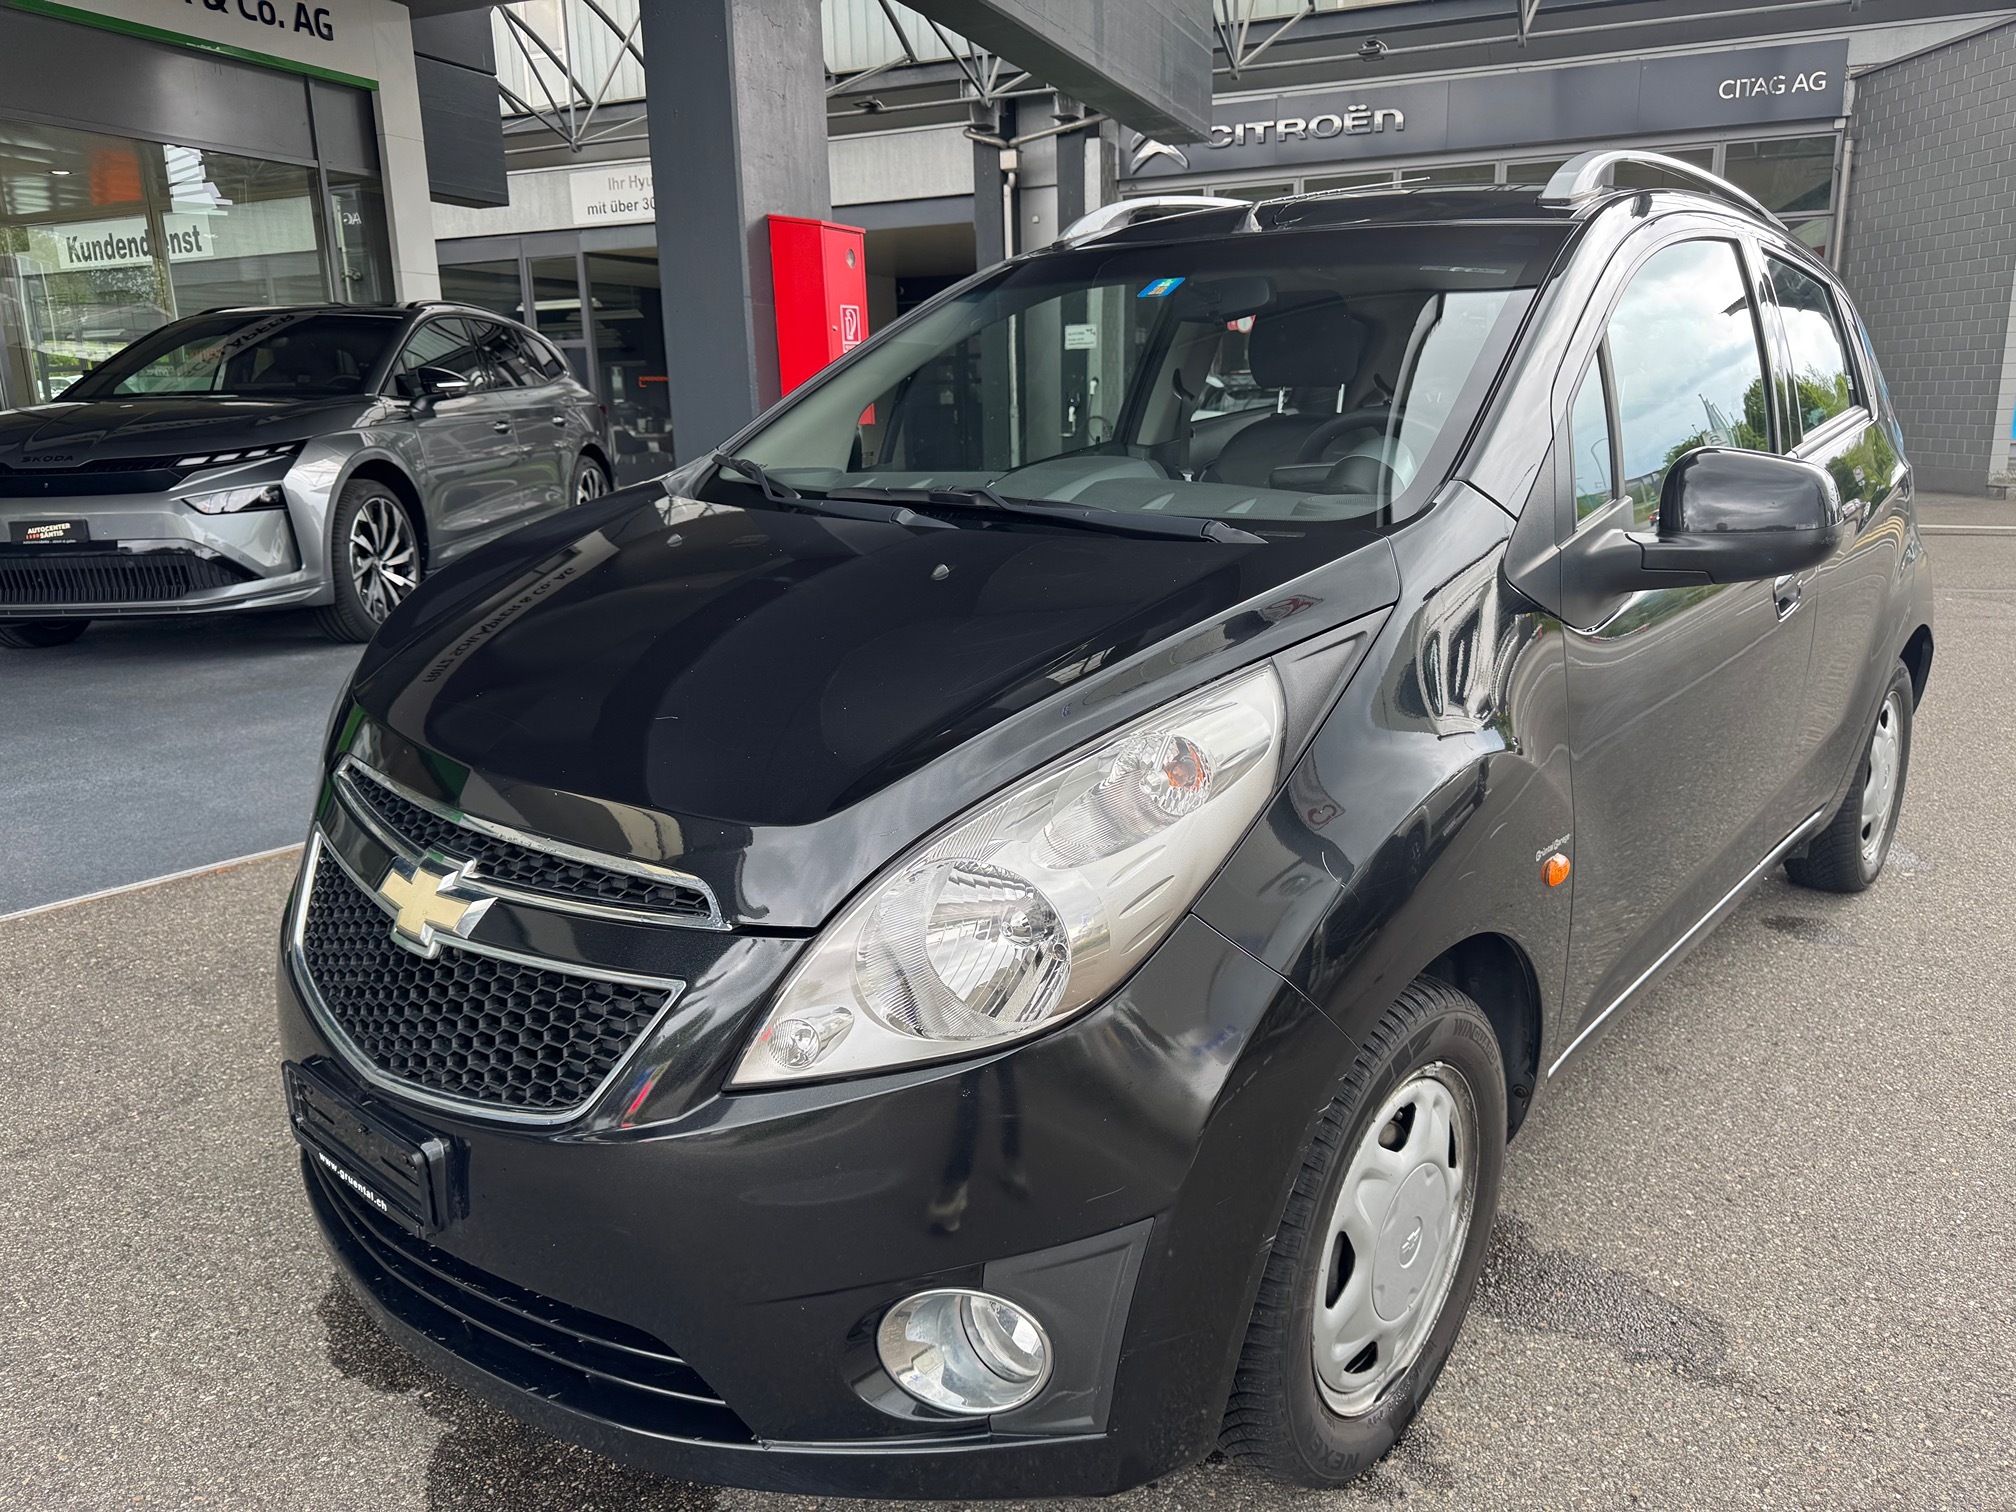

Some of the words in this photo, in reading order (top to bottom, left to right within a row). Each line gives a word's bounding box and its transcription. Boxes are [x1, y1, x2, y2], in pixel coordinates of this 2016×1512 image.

[293, 2, 334, 41] AG
[1718, 76, 1786, 100] CITAG
[1791, 70, 1827, 93] AG
[607, 176, 626, 191] Ihr
[587, 201, 607, 215] mit
[610, 199, 639, 214] über
[66, 224, 203, 264] Kundendnst
[27, 522, 71, 535] AUTOCENTER
[318, 1152, 388, 1212] www.gruental.ch
